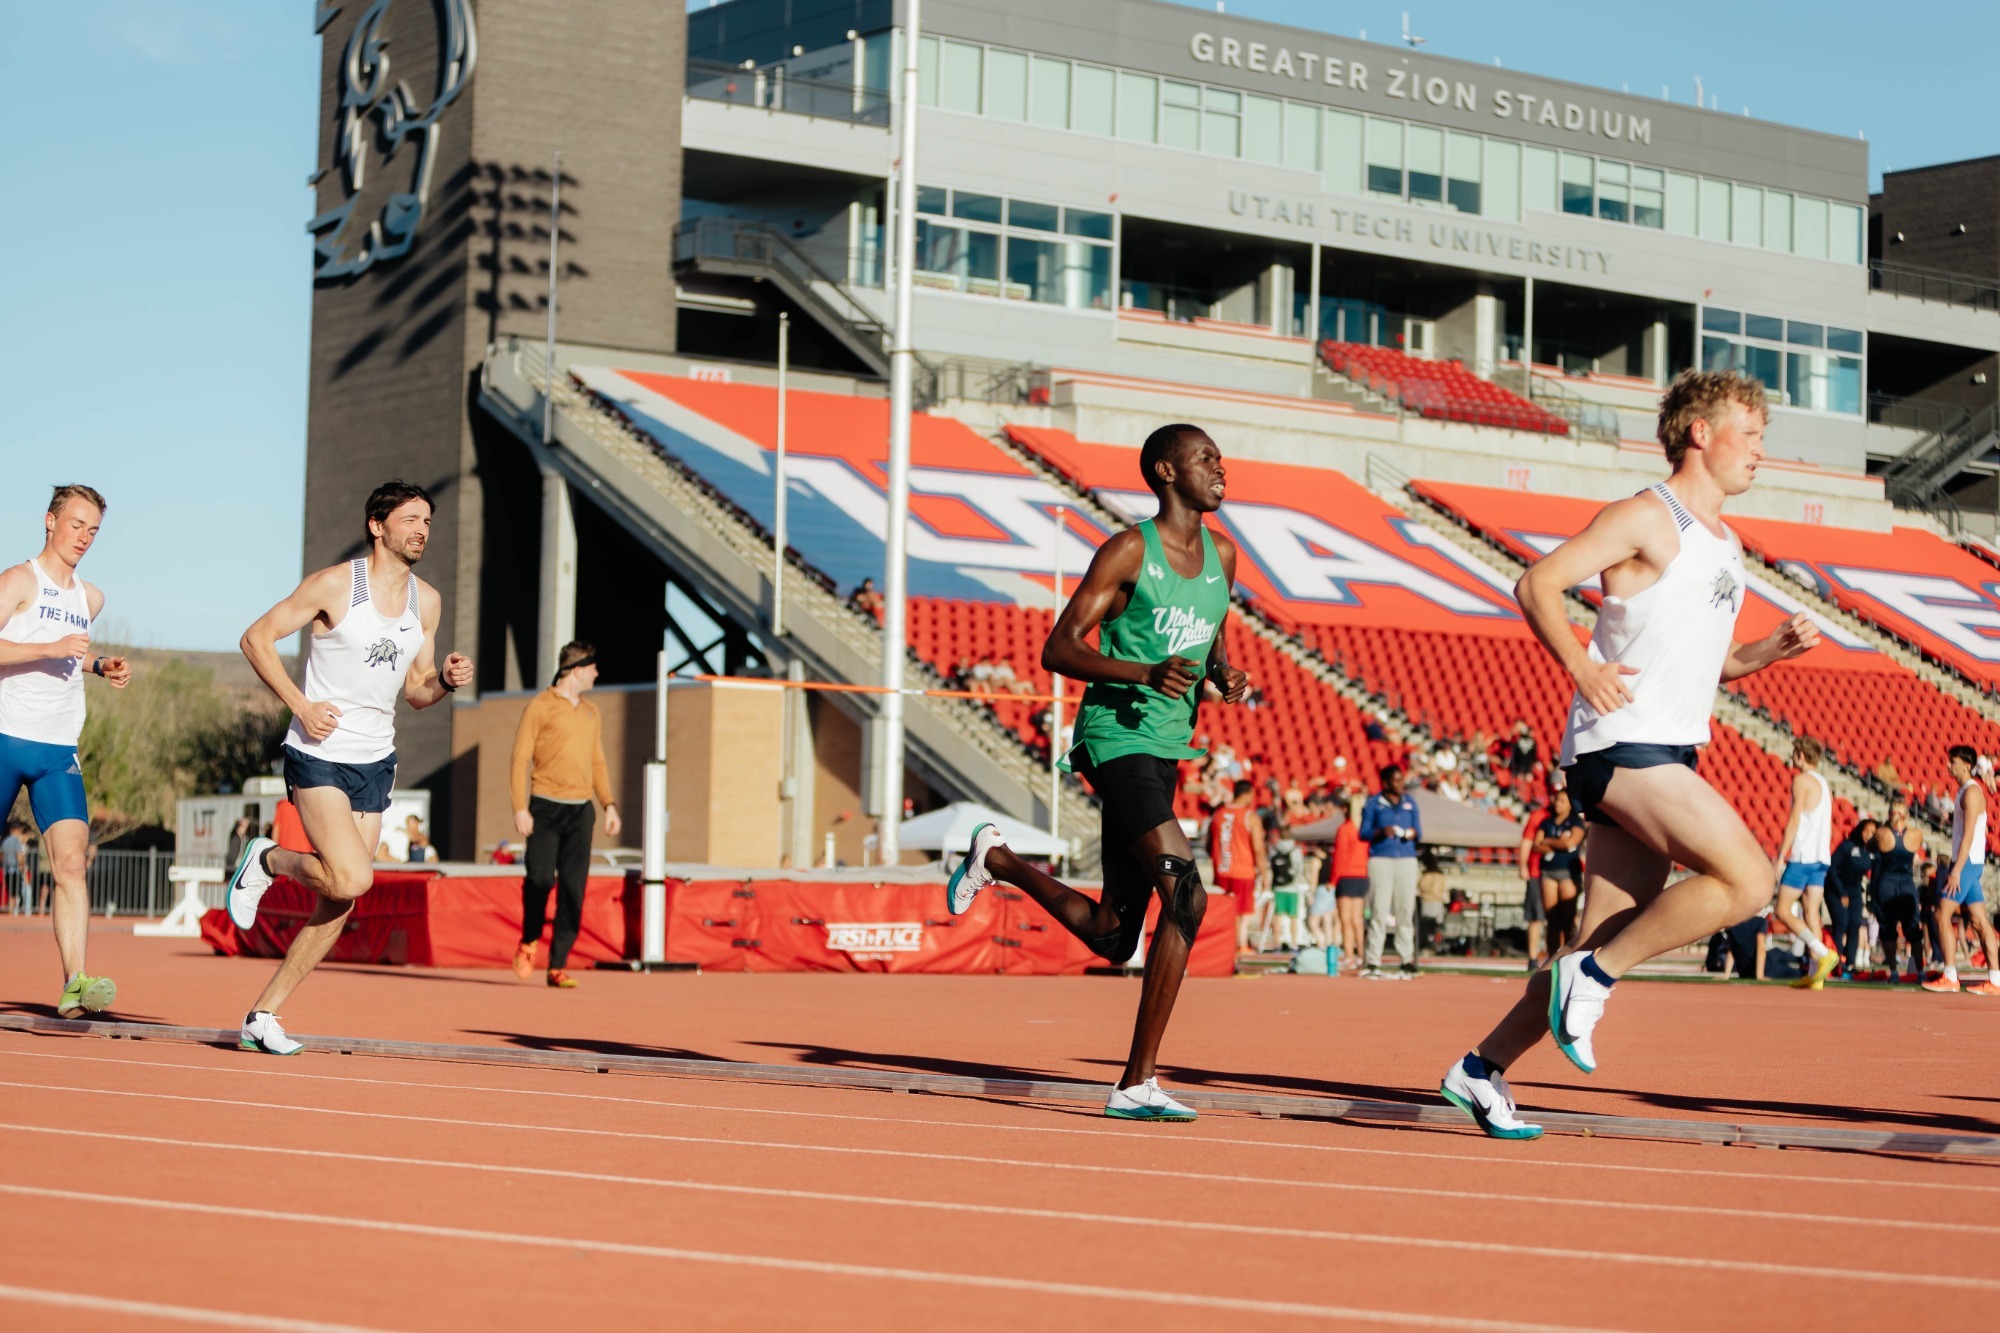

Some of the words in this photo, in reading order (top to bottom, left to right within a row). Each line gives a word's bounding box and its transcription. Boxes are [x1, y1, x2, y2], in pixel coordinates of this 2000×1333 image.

[1190, 31, 1370, 92] GREATER
[1386, 67, 1477, 113] ZION
[1492, 89, 1653, 146] STADIUM
[1228, 190, 1315, 229] UTAH
[1330, 206, 1413, 243] TECH
[1429, 223, 1612, 275] UNIVERSITY
[39, 605, 62, 621] THE
[65, 611, 88, 630] FARM
[1152, 605, 1196, 635] Utah
[1166, 618, 1216, 655] Valley
[875, 929, 923, 947] PLACE
